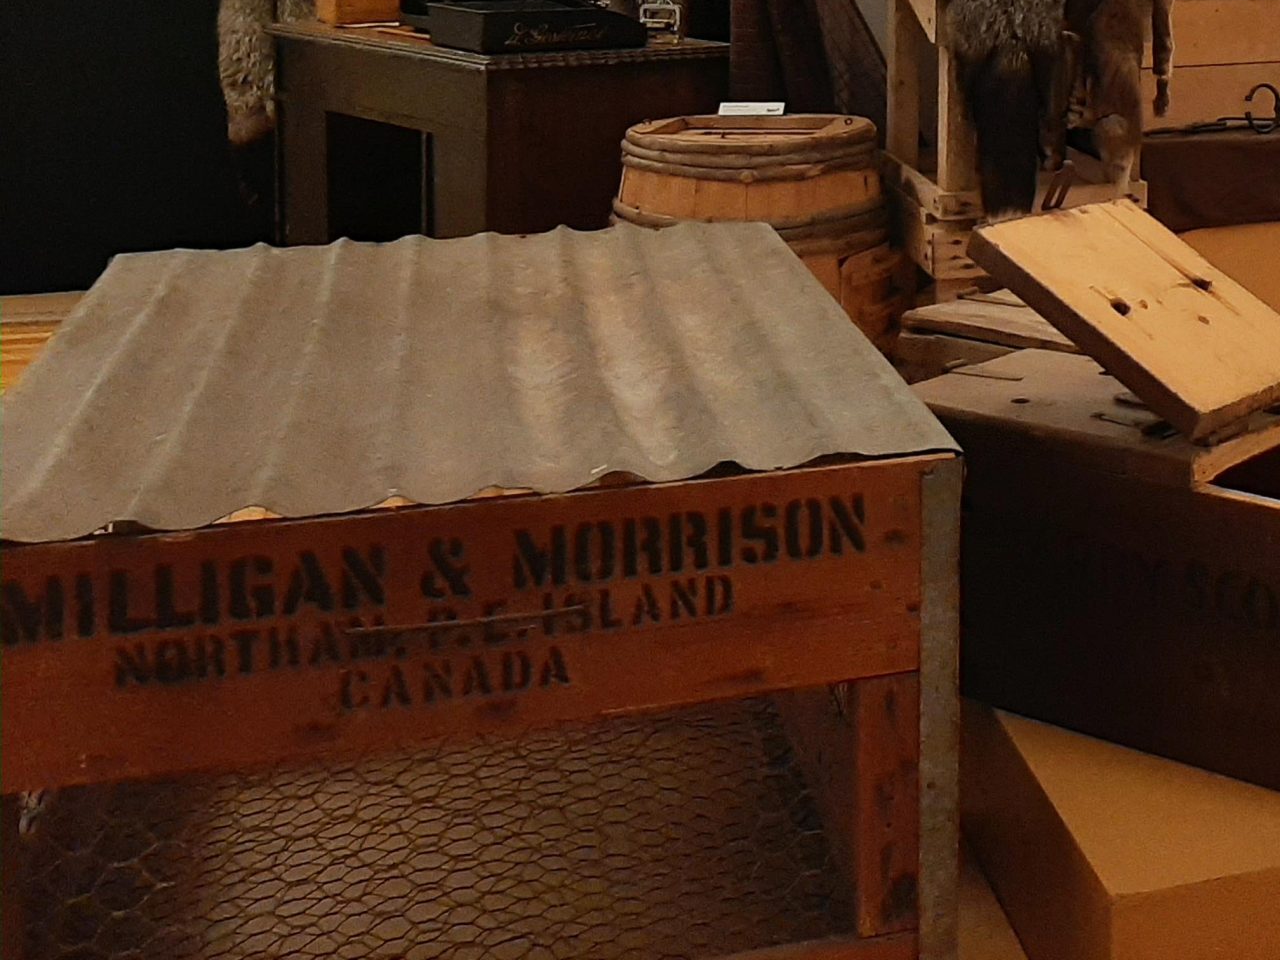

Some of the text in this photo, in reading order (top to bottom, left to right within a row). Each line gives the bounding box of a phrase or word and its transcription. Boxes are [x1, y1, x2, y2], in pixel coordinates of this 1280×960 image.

[0, 493, 867, 648] MILLIGAN & MORRISON
[542, 574, 735, 637] ISLAND
[340, 644, 571, 711] CANADA
